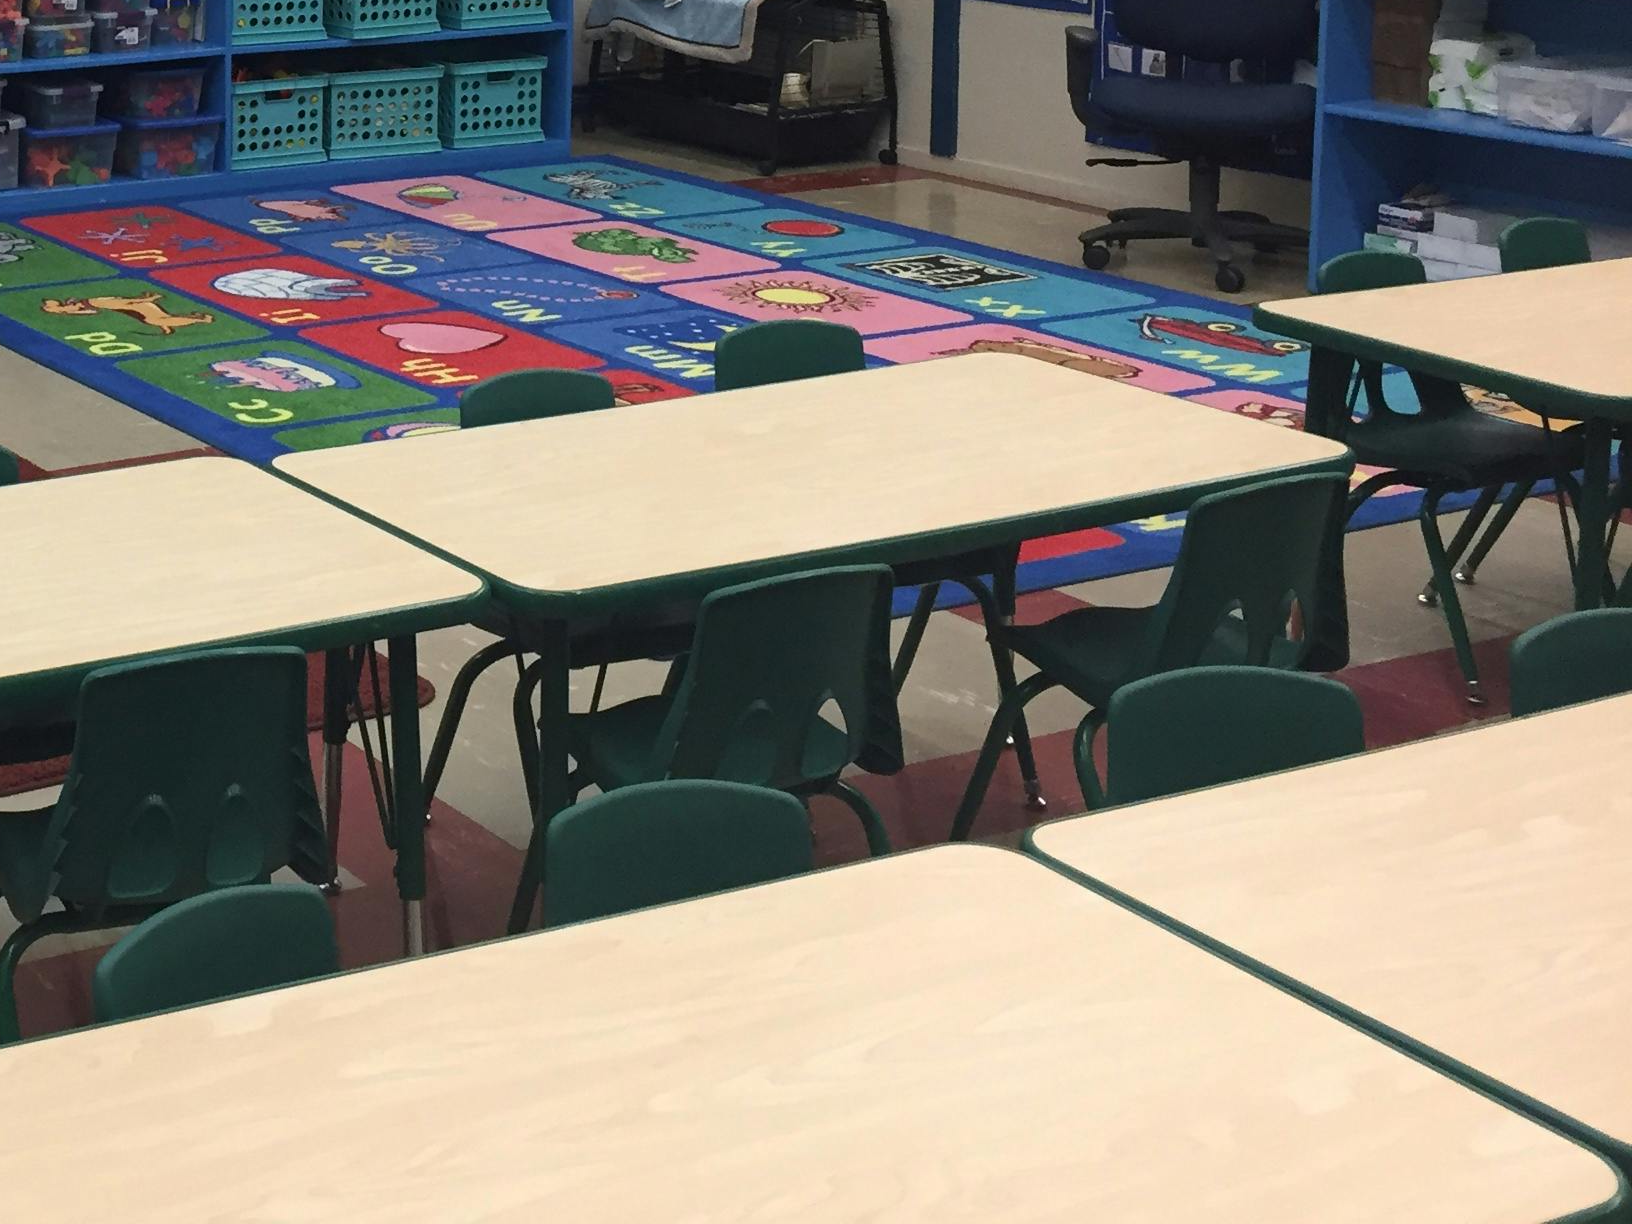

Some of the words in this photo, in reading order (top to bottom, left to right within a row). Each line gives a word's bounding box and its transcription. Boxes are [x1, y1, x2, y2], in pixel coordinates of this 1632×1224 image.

[359, 256, 418, 275] Oo
[64, 332, 143, 355] Dd
[399, 358, 479, 385] Hh
[228, 398, 294, 423] Cc
